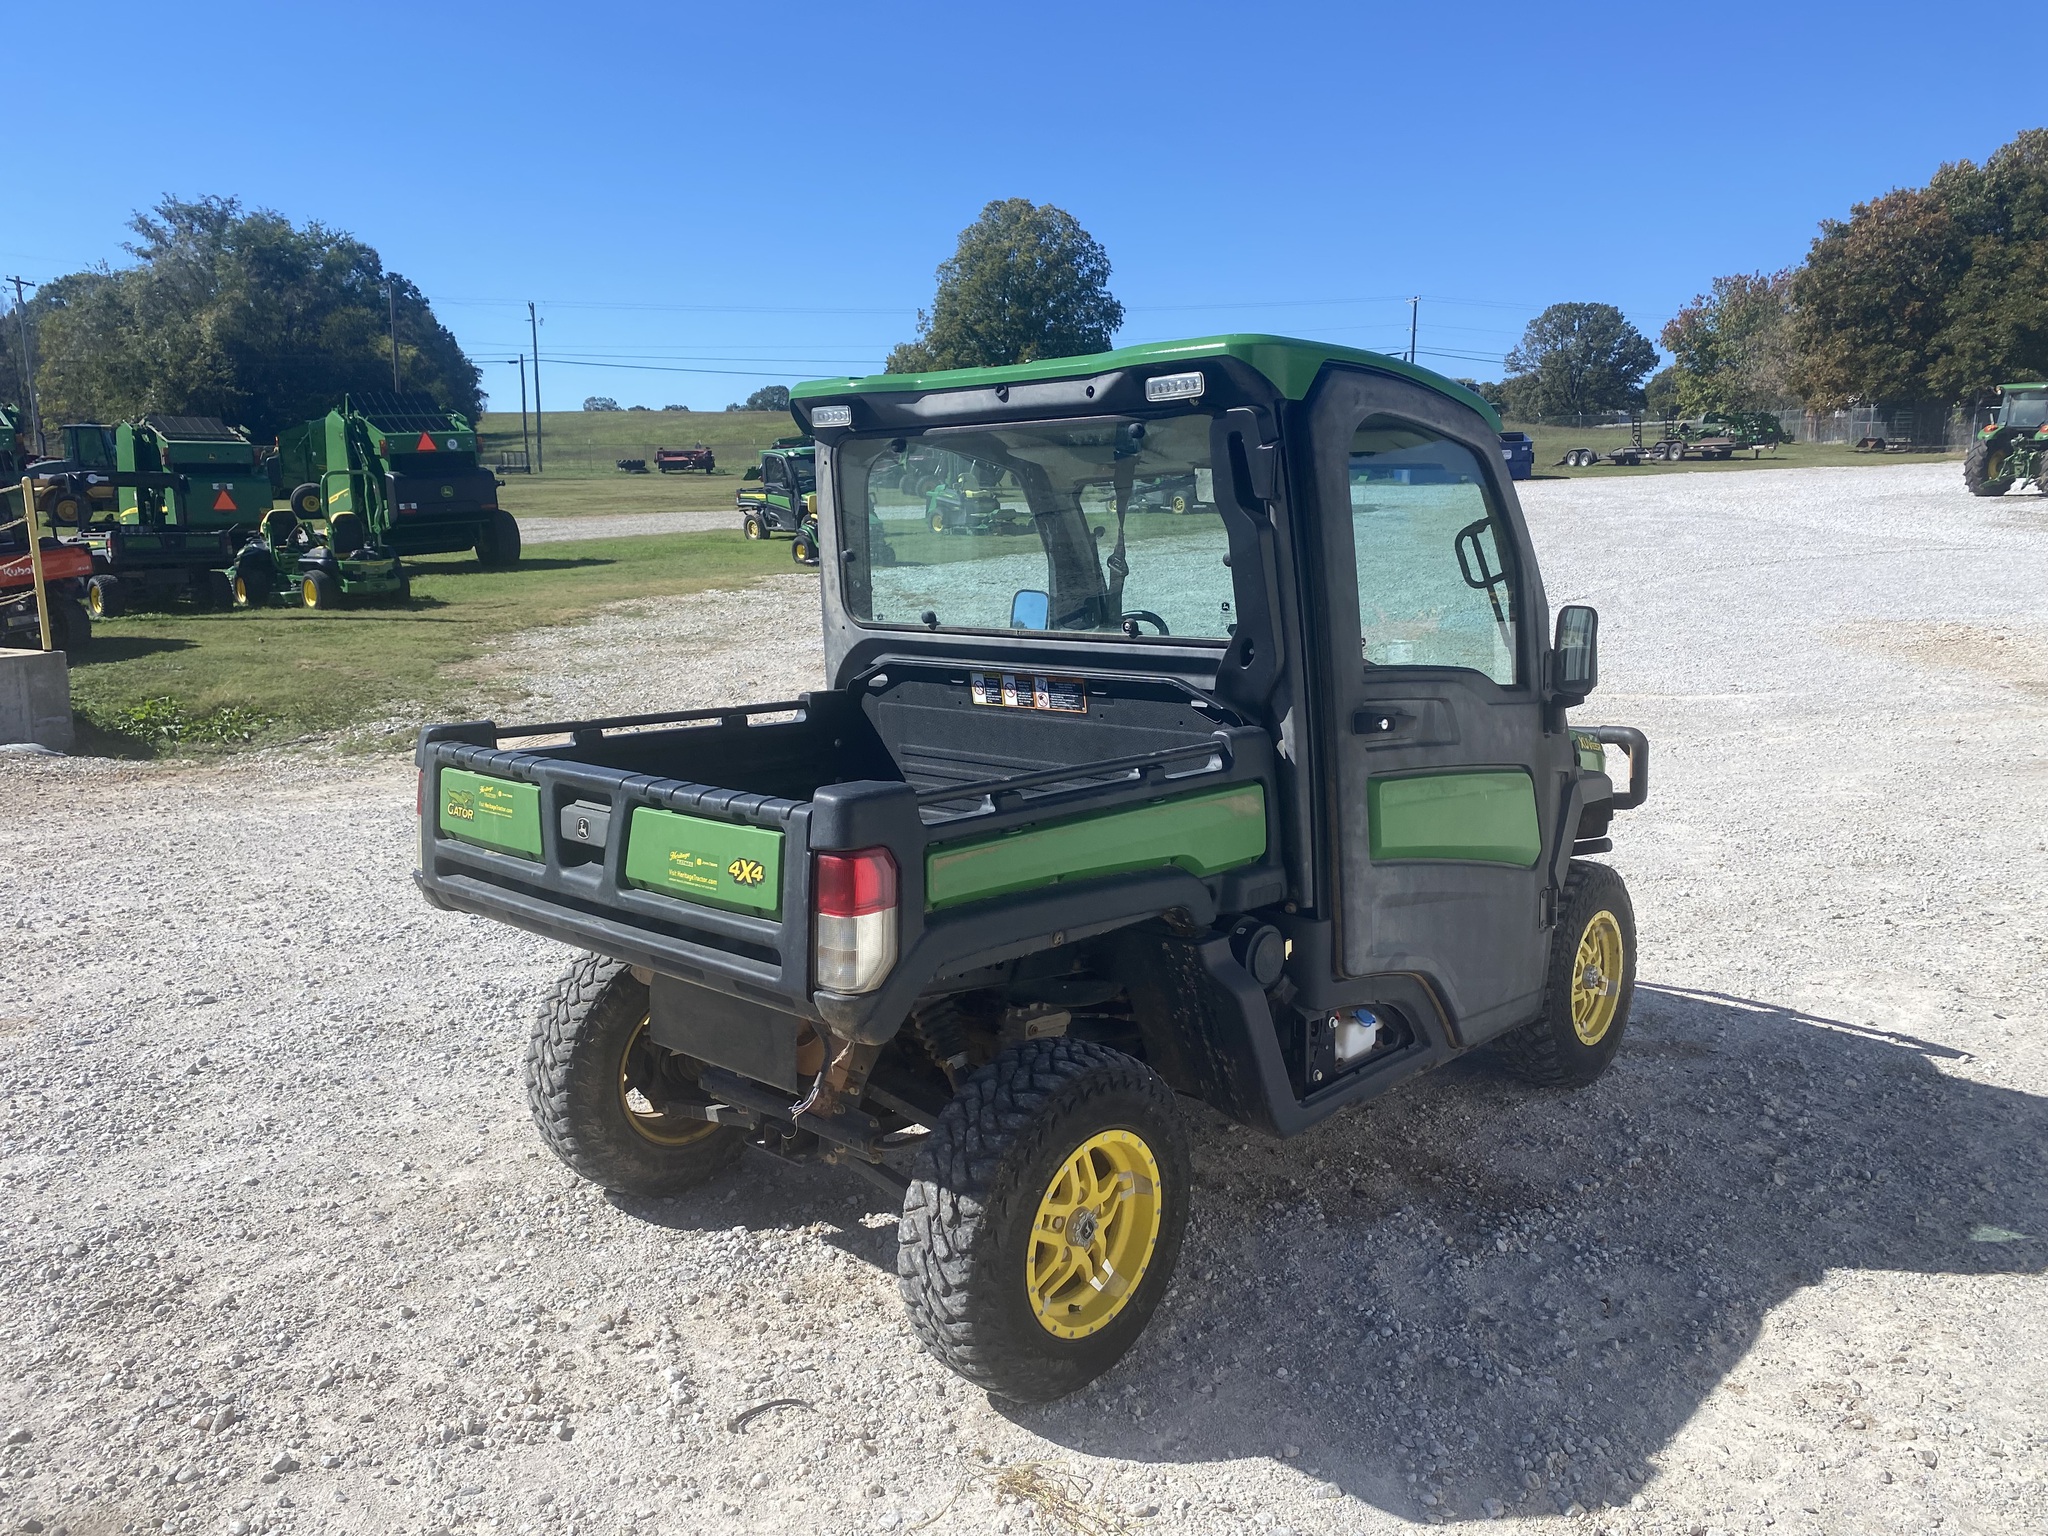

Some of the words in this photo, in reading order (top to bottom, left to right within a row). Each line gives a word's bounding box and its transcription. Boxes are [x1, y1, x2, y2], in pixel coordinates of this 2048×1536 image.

[3, 565, 34, 576] Kubo
[447, 802, 474, 820] GATOR
[728, 859, 763, 884] 4X4
